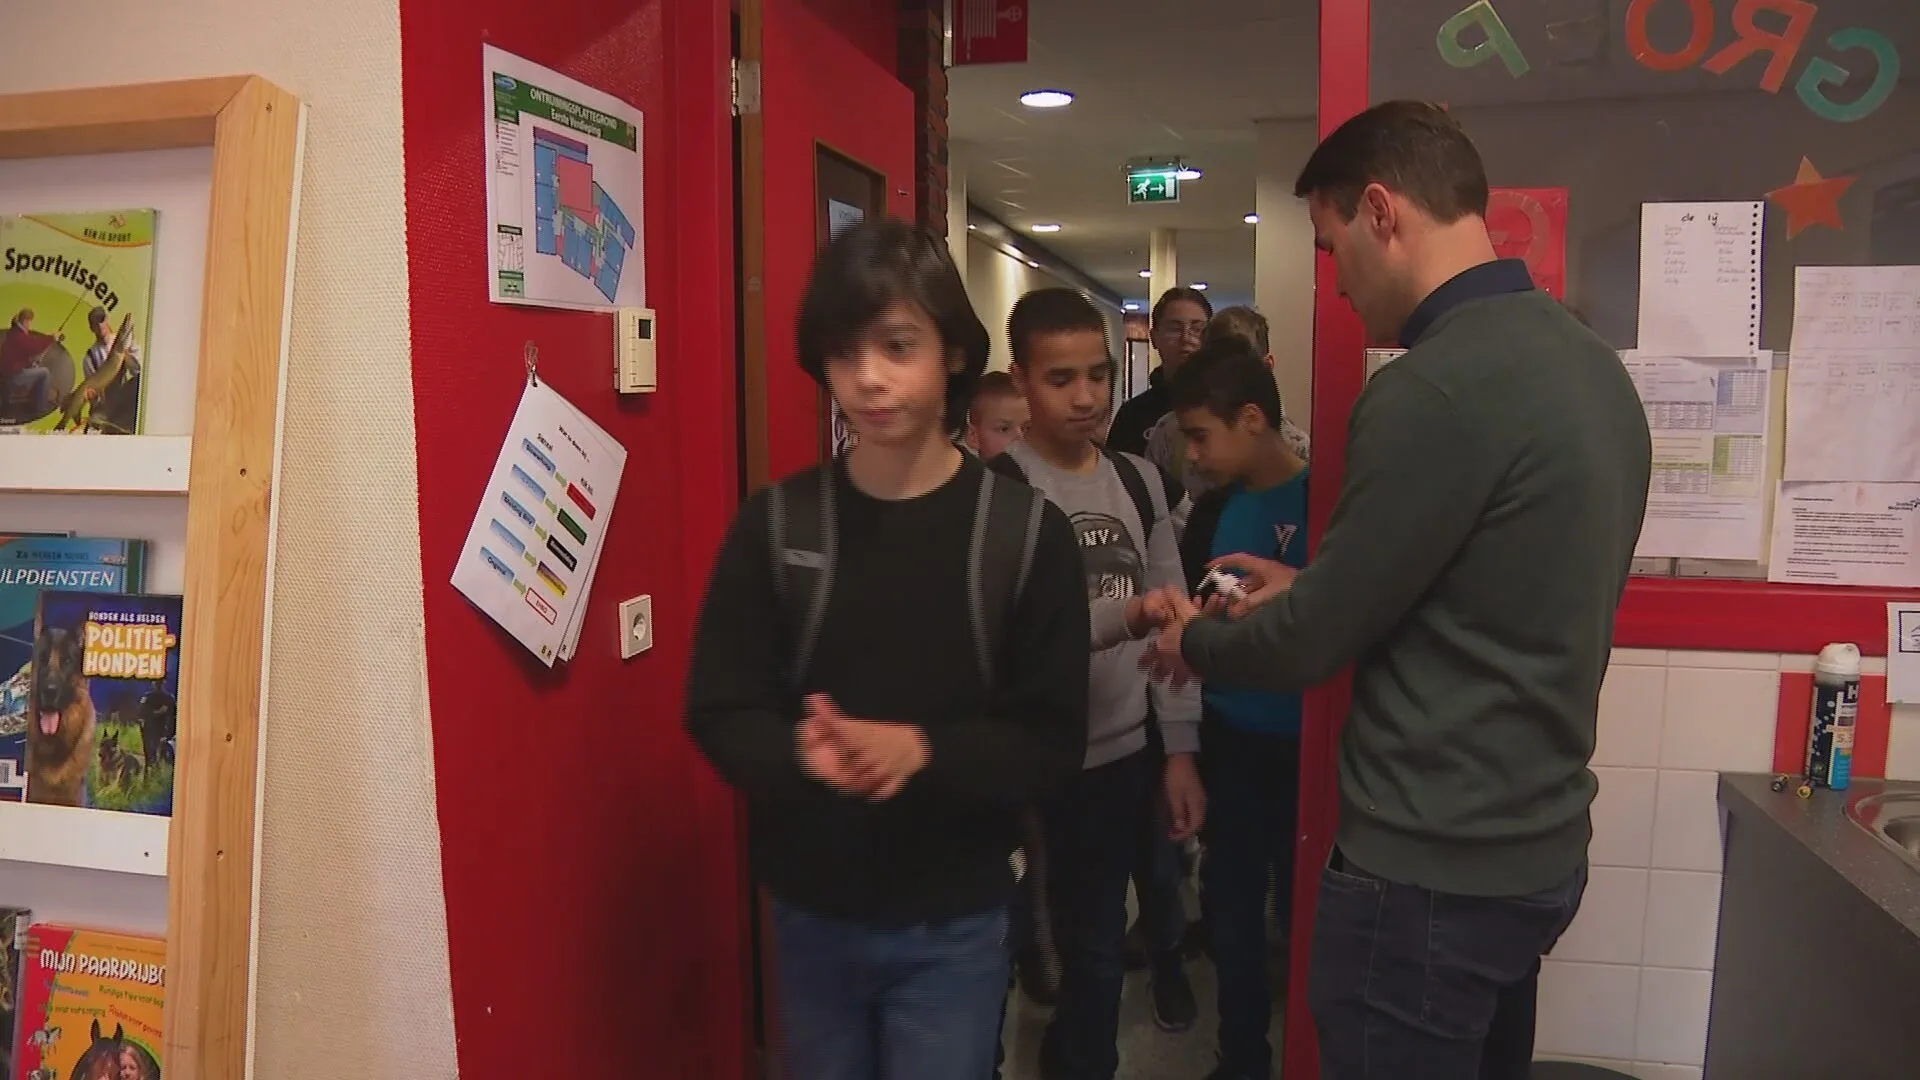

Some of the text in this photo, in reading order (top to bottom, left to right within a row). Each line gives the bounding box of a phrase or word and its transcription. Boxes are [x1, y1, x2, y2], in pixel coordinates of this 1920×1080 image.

[4, 247, 119, 313] Sportvissen
[88, 611, 166, 624] HONDEN ALS HELDEN
[87, 625, 174, 651] POLITIE-
[84, 651, 163, 677] HONDEN
[40, 949, 76, 974] MIJN
